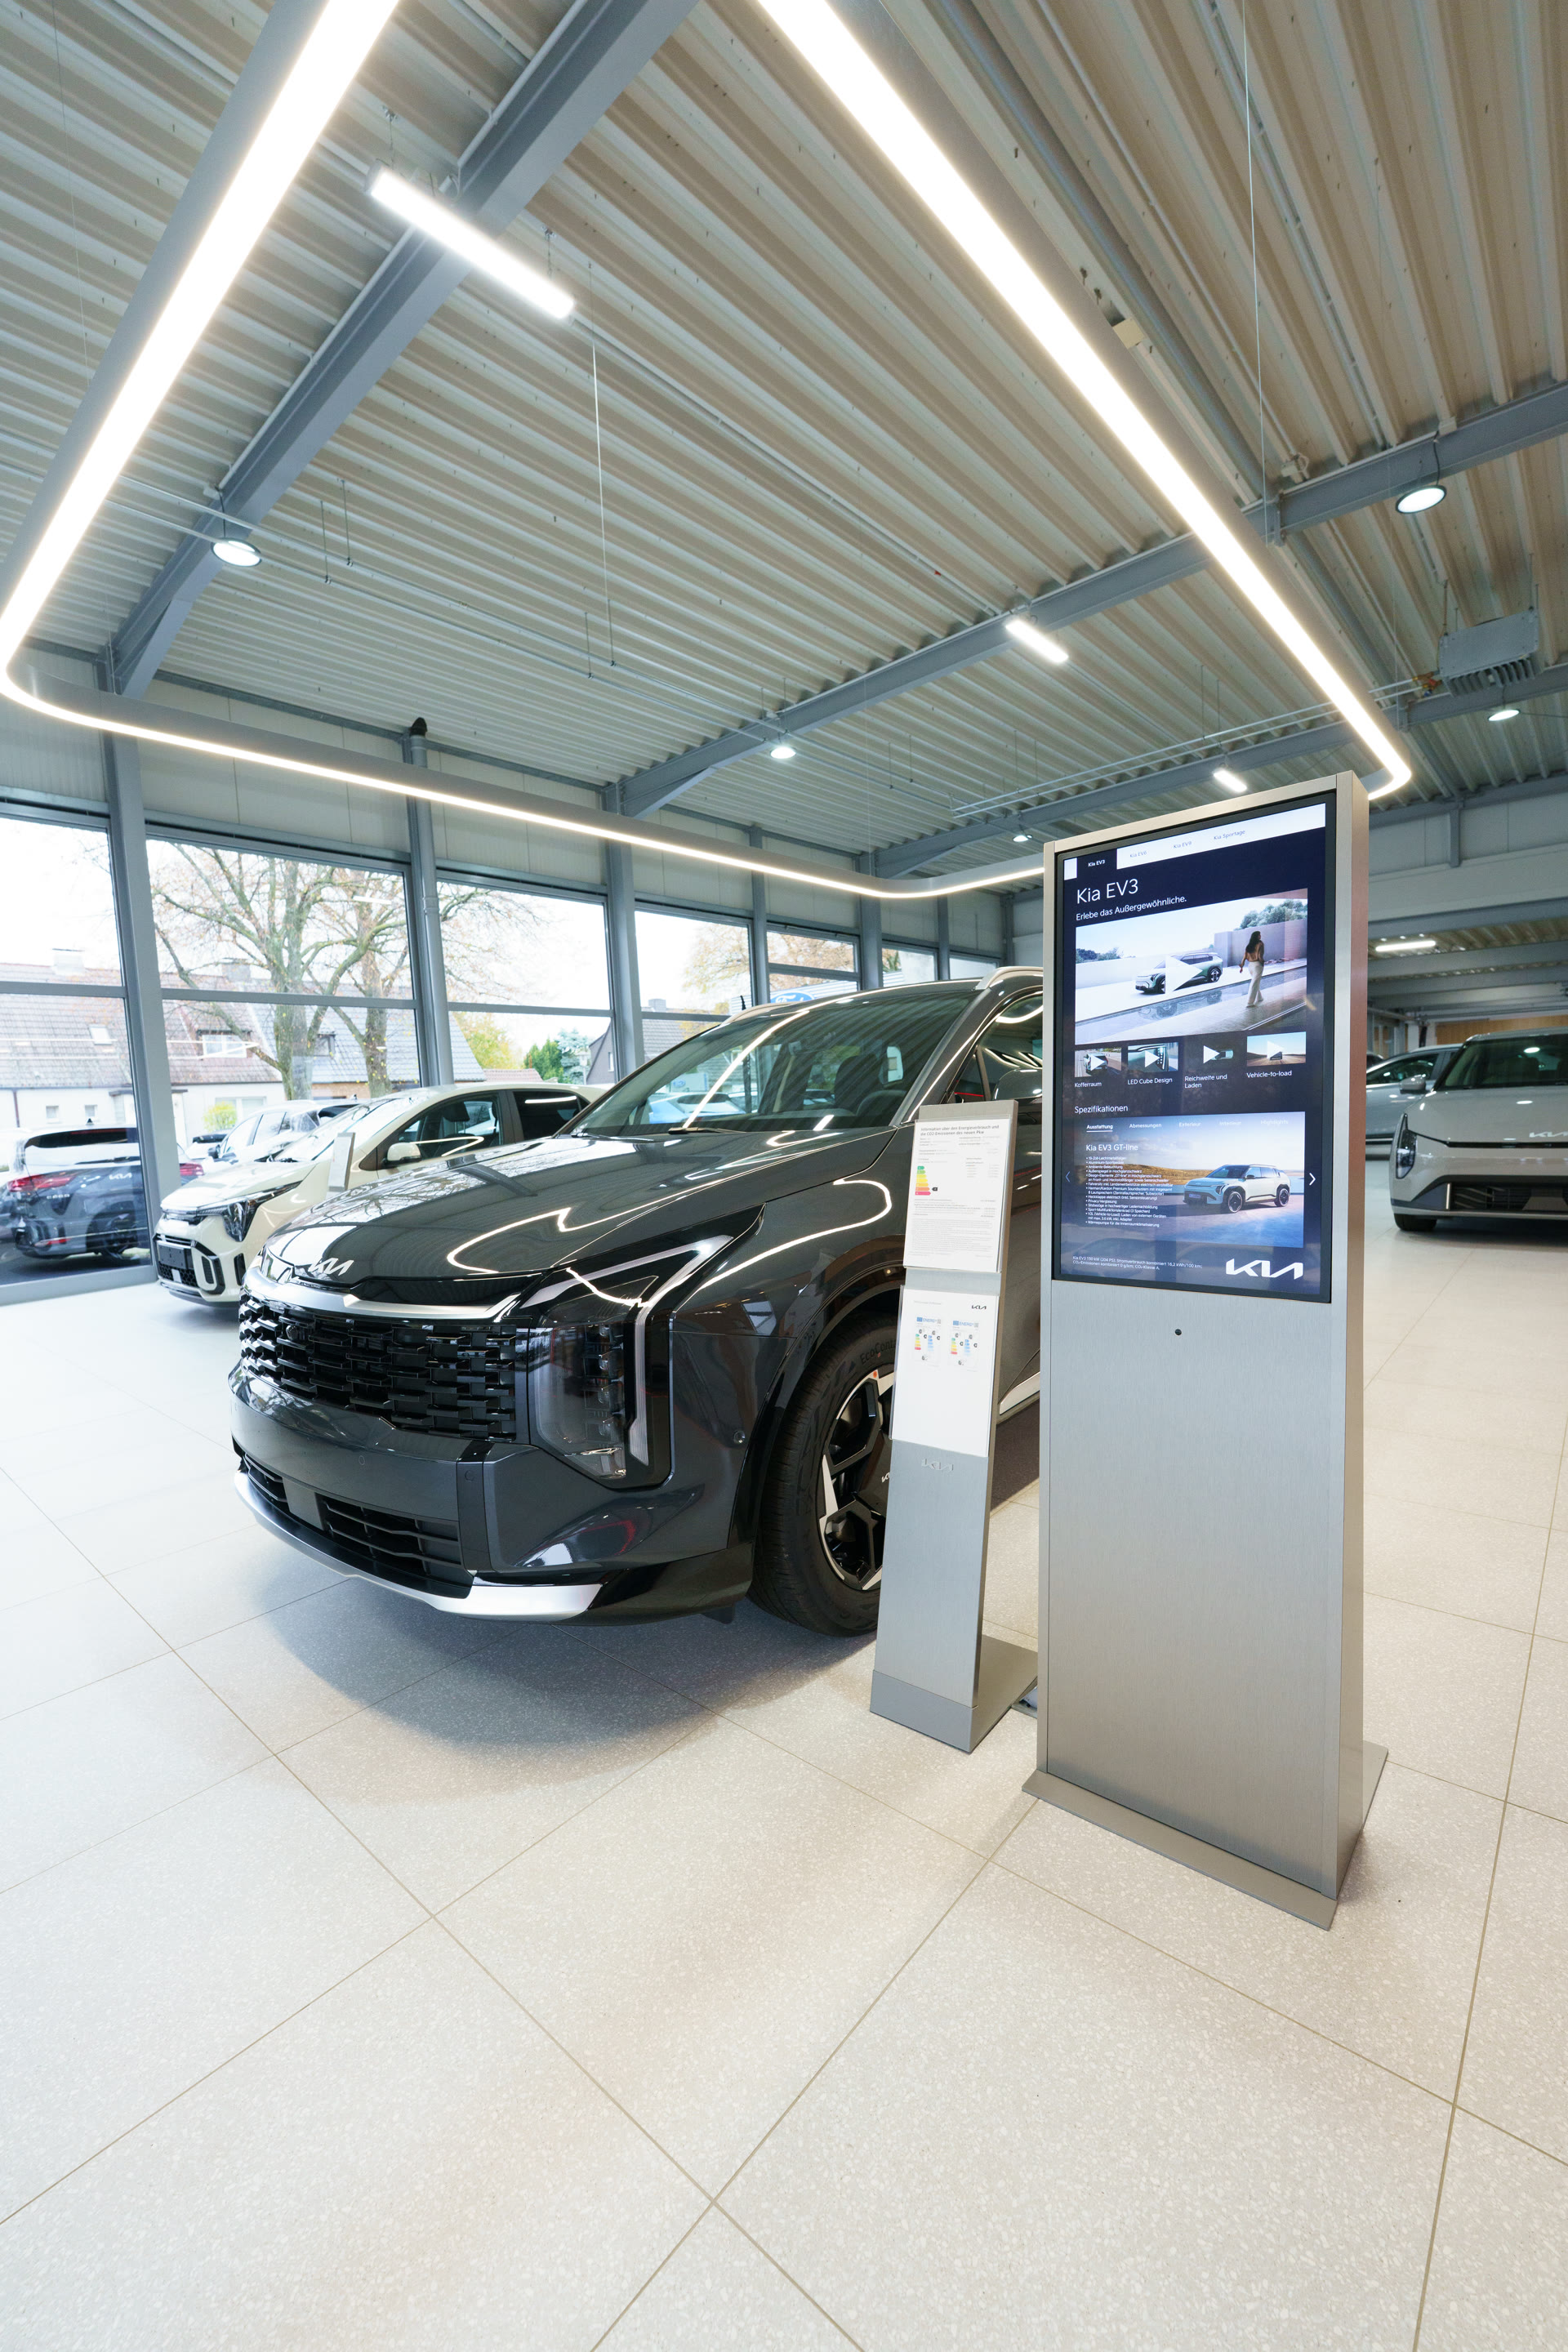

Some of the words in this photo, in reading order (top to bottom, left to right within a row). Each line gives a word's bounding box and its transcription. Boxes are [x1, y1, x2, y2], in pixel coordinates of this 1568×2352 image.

[1223, 830, 1245, 840] Sportage
[1077, 888, 1101, 904] Kia
[1107, 879, 1138, 898] EV3
[1076, 911, 1098, 921] Erlebe
[1100, 908, 1112, 916] das
[1115, 896, 1187, 915] Außergewöhnliche.
[1247, 1070, 1292, 1078] Vehicle-to-load
[1075, 1105, 1128, 1116] Spezifikationen
[307, 1258, 354, 1276] KIA
[1226, 1258, 1303, 1280] KIA
[921, 1459, 954, 1472] KIA
